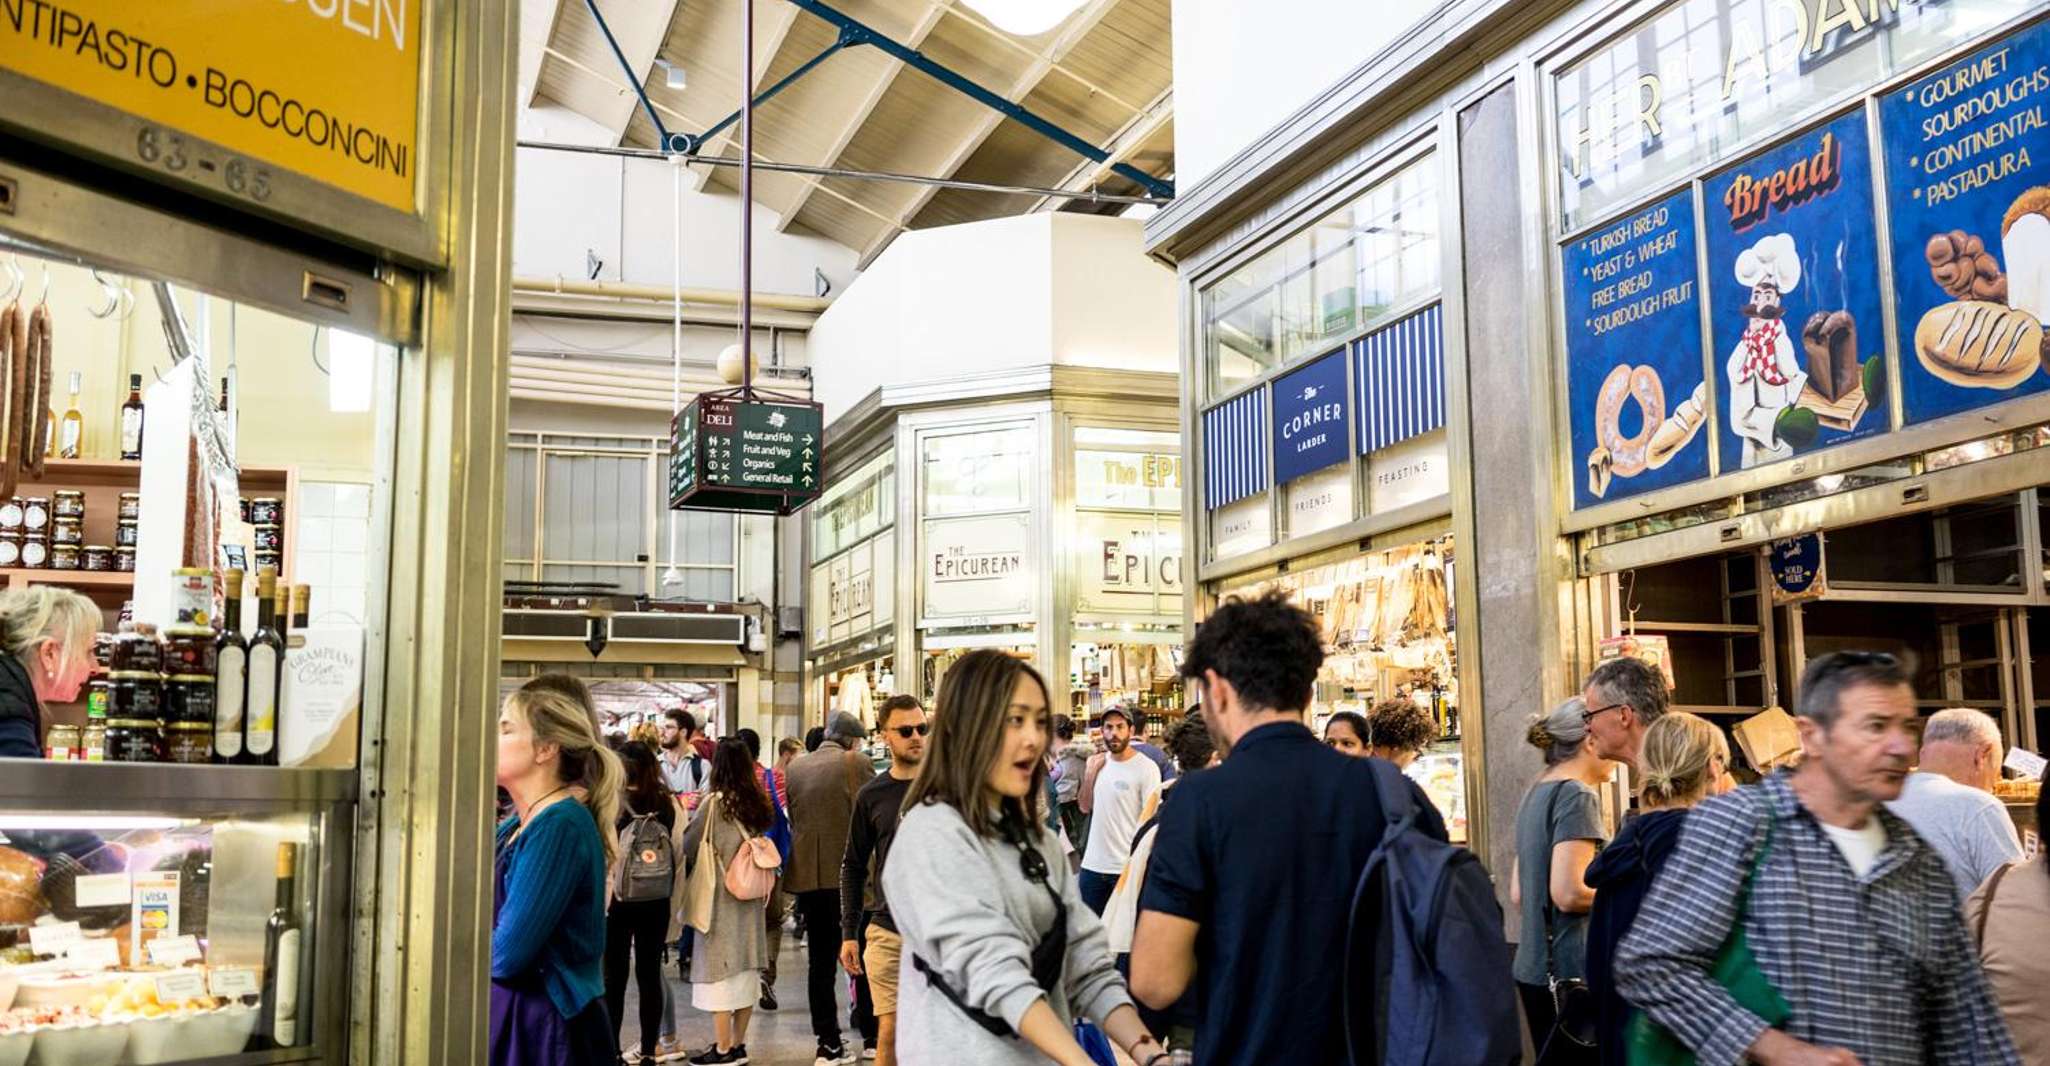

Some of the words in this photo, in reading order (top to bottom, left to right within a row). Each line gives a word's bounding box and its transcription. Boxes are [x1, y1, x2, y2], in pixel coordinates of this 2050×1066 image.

[1920, 48, 2010, 108] GOURMET
[204, 67, 407, 178] BOCCONCINI
[1922, 66, 2049, 141] SOURDOUGHS
[1925, 105, 2048, 174] CONTINENTAL
[1724, 132, 1836, 224] Bread
[1927, 147, 2031, 208] PASTADURA
[1590, 223, 1631, 257] TURKISH
[1633, 207, 1669, 238] BREAD
[1590, 254, 1623, 283] YEAST
[1625, 250, 1636, 269] &
[1638, 230, 1678, 262] WHEAT
[1592, 284, 1616, 310] FREE
[1618, 271, 1653, 300] BREAD
[1594, 294, 1660, 336] SOURDOUGH
[1662, 281, 1693, 310] FRUIT
[706, 414, 732, 426] DELI
[743, 430, 763, 440] Meat
[763, 432, 778, 441] and
[779, 432, 794, 443] Fish
[1282, 402, 1342, 440] CORNER
[743, 444, 760, 454] Fruit
[761, 445, 776, 455] and
[776, 446, 791, 458] Veg
[1297, 433, 1327, 452] LARDER
[743, 458, 775, 470] Organics
[743, 471, 771, 482] General
[772, 474, 793, 484] Retail
[1378, 461, 1429, 485] FEASTING
[935, 553, 1019, 577] EPICUREAN
[145, 891, 169, 902] VISA
